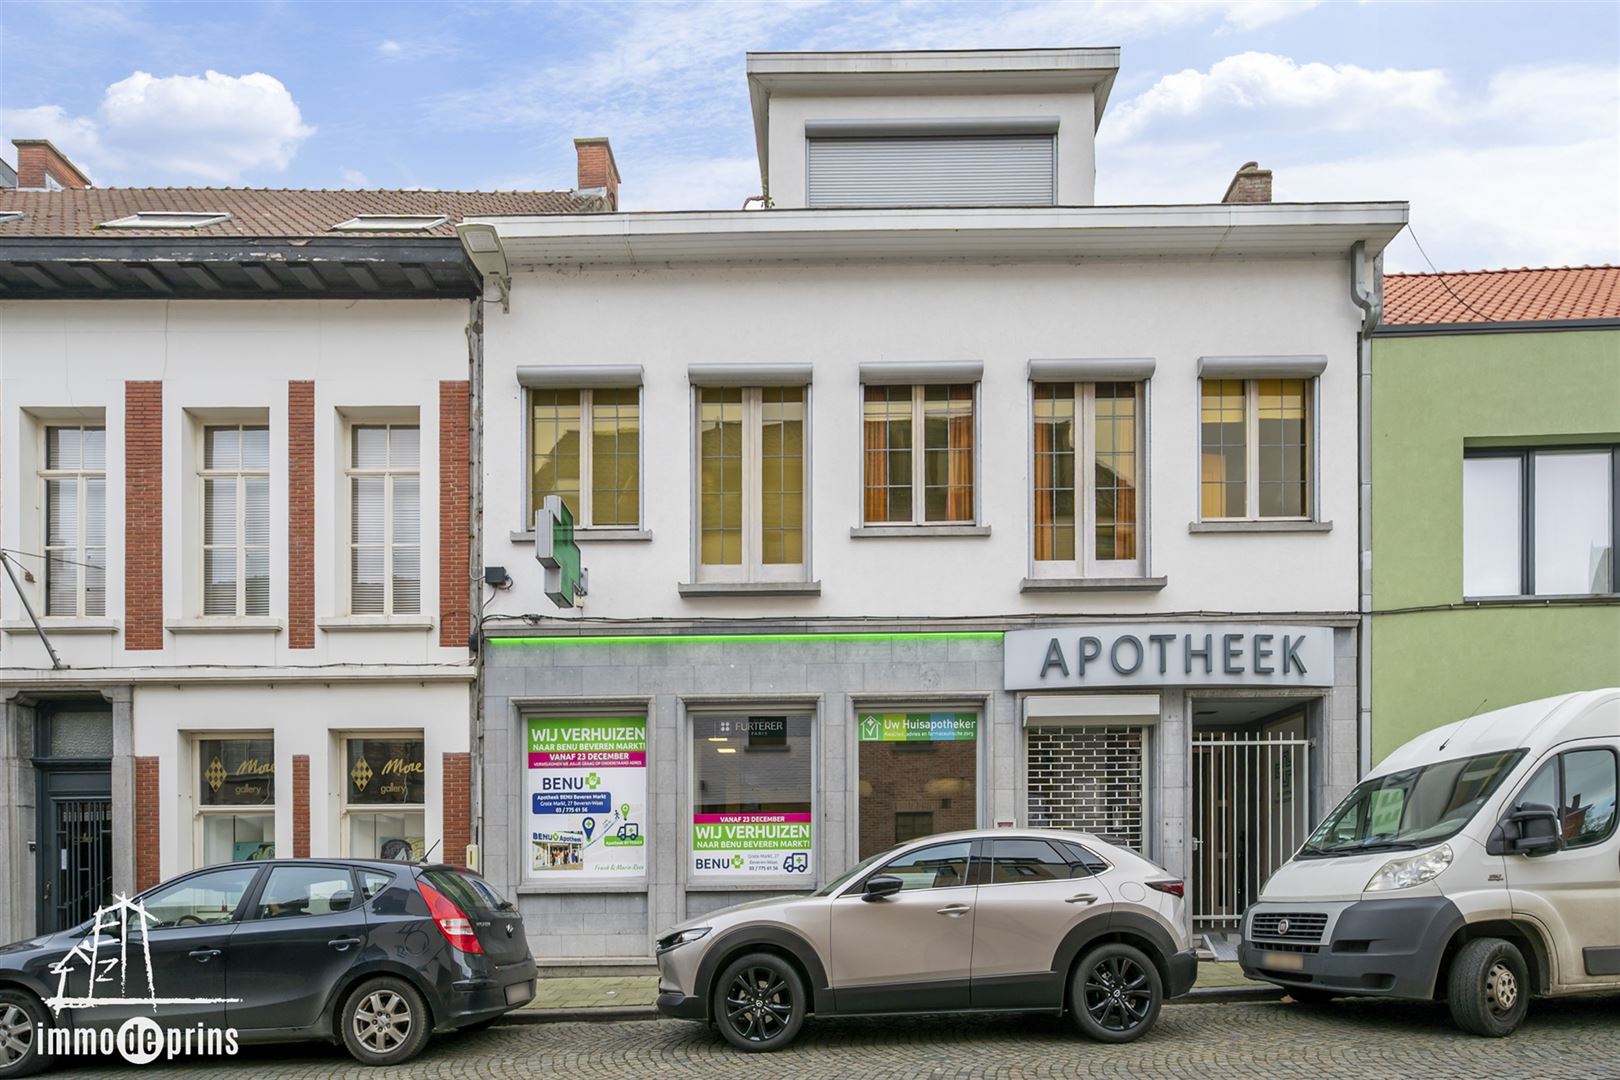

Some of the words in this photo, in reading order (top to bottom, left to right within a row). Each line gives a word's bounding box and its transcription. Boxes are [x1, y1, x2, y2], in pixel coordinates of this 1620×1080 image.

[1040, 634, 1308, 678] APOTHEEK
[735, 721, 783, 731] FURTERER
[884, 720, 900, 730] Uw
[903, 719, 976, 731] Huisapotheker
[531, 728, 558, 742] WIJ
[561, 727, 645, 741] VERHUIZEN
[533, 743, 555, 751] NAAR
[557, 743, 578, 751] BENU
[579, 742, 615, 751] BEVEREN
[616, 742, 646, 750] MARKT!
[549, 753, 576, 761] VANAF
[587, 752, 630, 760] DECEMBER
[381, 758, 424, 775] More
[542, 777, 584, 790] BENU
[533, 832, 553, 841] BENU
[695, 825, 722, 839] WIJ
[725, 824, 810, 839] VERHUIZEN
[696, 841, 719, 849] NAAR
[743, 840, 778, 848] BEVEREN
[695, 858, 730, 870] BENU
